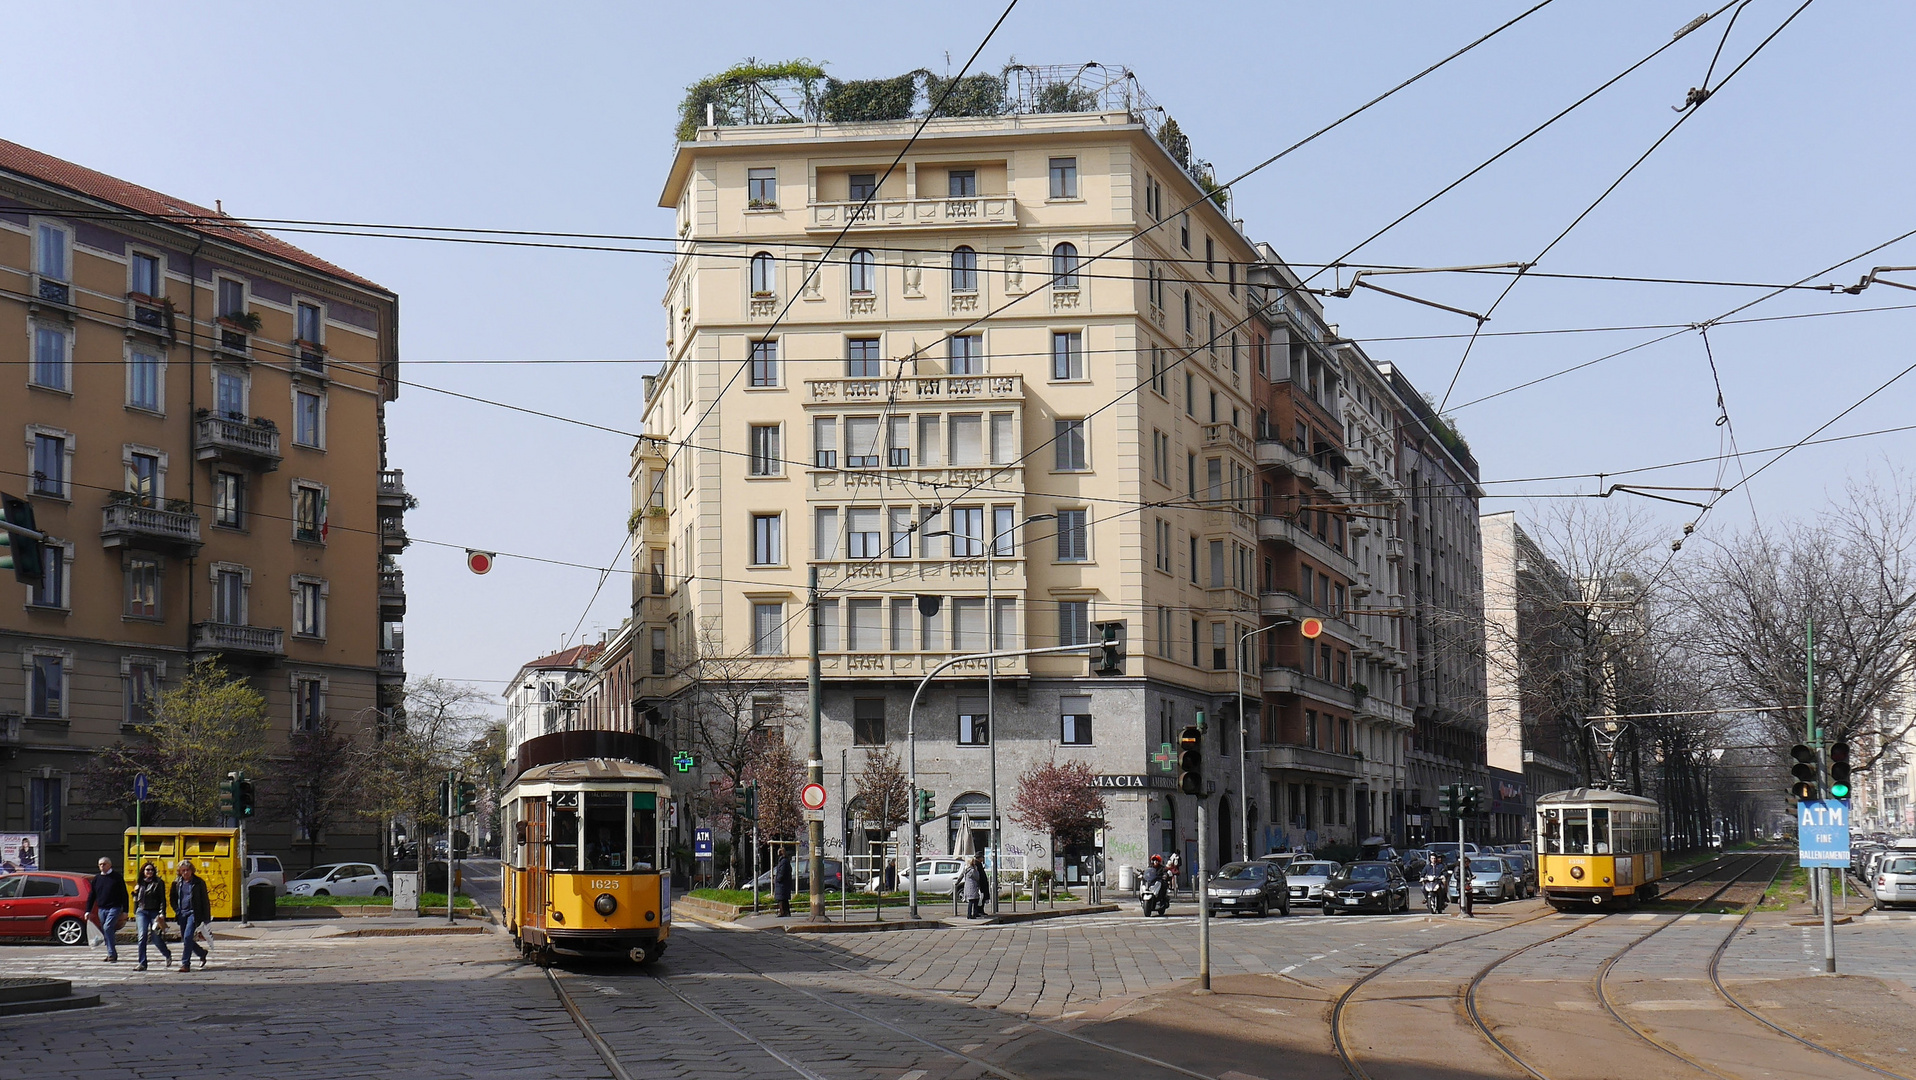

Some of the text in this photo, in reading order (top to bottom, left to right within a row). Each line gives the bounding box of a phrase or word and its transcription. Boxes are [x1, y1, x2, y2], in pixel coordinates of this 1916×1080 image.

[1088, 776, 1144, 787] MACIA
[556, 792, 578, 807] 23
[1816, 833, 1832, 843] FINE
[1799, 850, 1850, 860] RALLENTAMENTO
[591, 880, 619, 889] 1625
